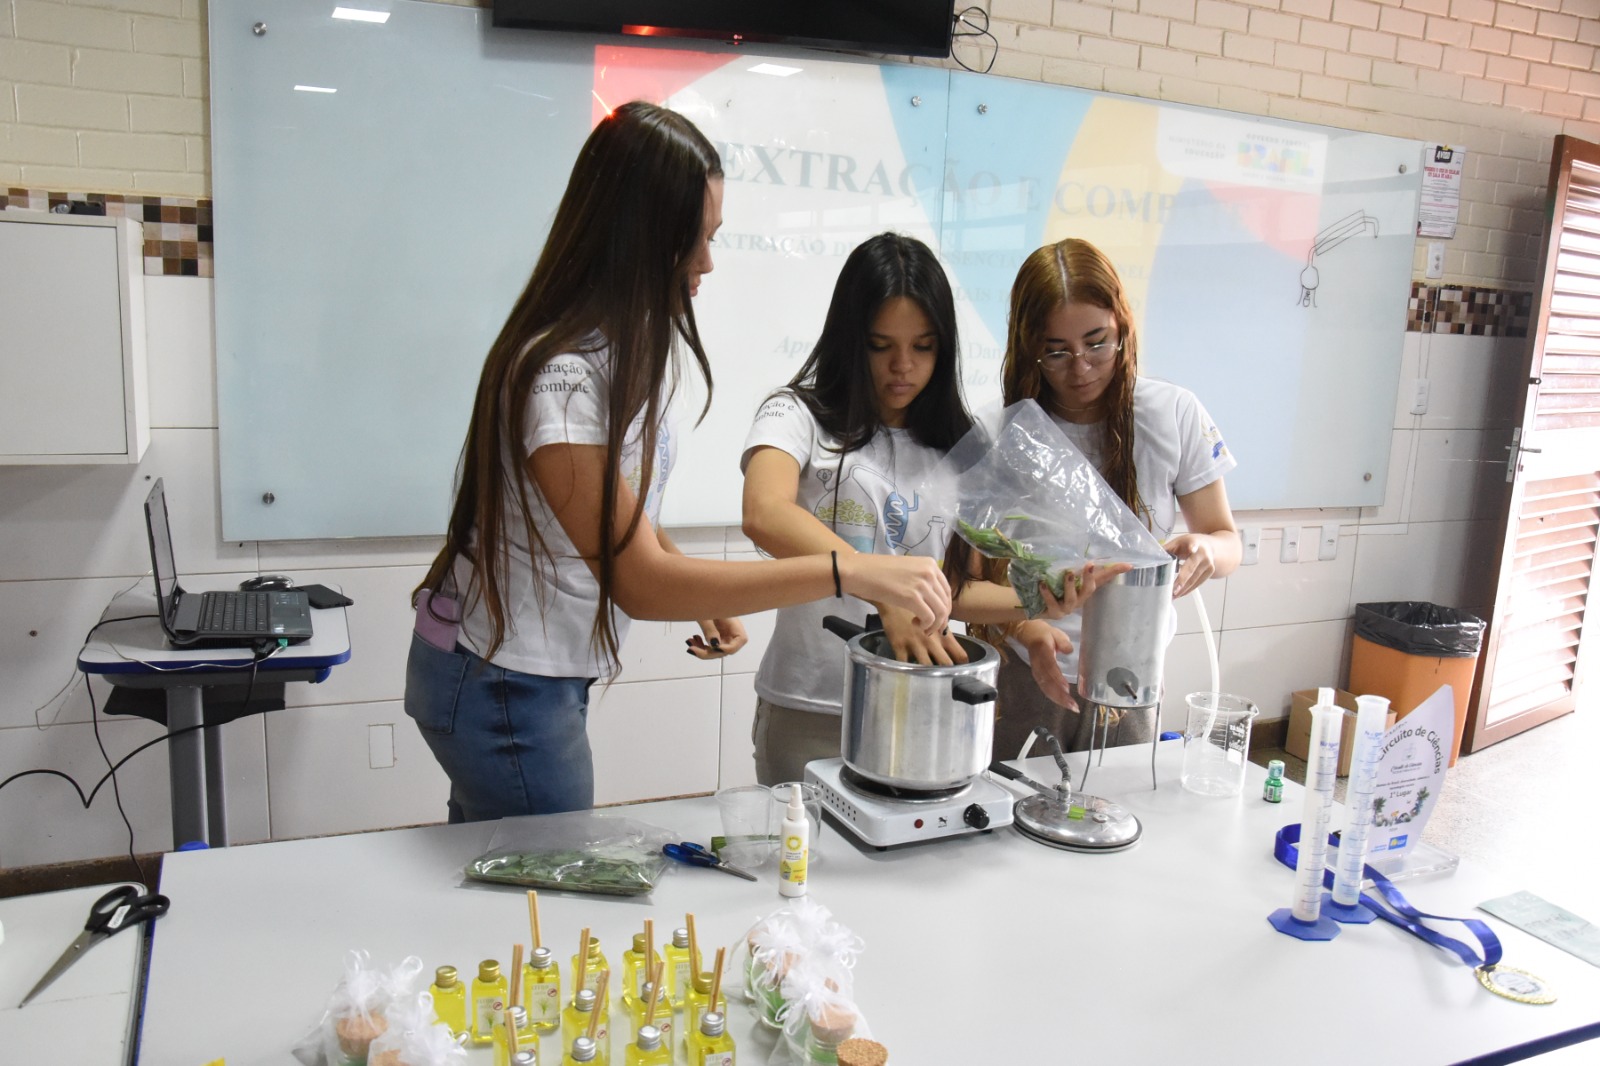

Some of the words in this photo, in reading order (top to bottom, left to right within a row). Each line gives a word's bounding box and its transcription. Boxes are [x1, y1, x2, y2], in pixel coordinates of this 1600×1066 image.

[714, 140, 1002, 207] EXTRAÇÃO
[1018, 175, 1042, 212] E
[538, 362, 583, 377] tração
[532, 379, 590, 395] combate
[1415, 724, 1427, 737] de
[1427, 730, 1444, 775] Ciências
